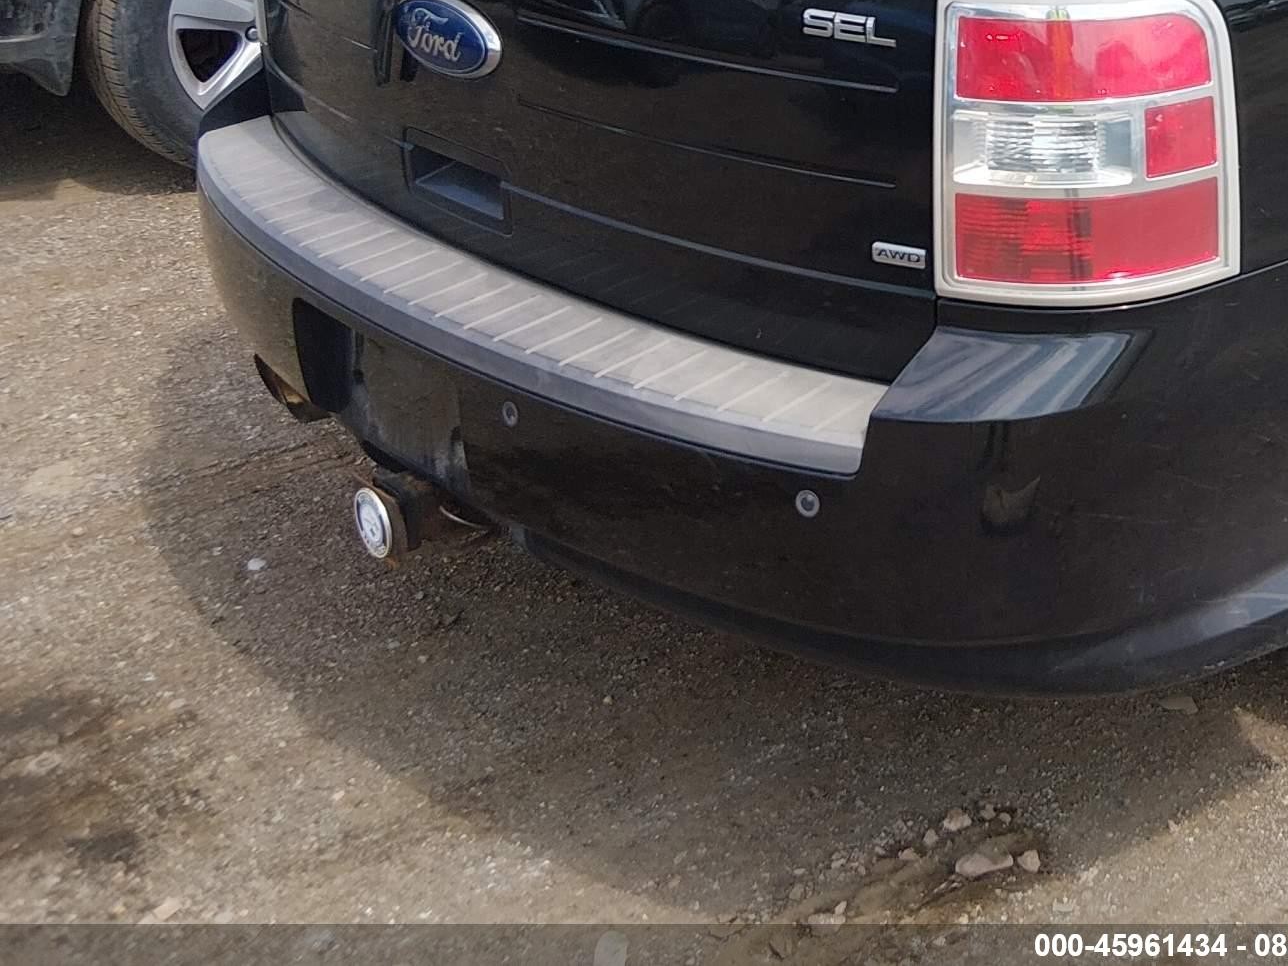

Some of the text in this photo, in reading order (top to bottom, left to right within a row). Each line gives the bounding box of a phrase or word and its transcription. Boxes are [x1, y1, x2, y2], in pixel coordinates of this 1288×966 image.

[404, 7, 465, 63] Ford
[802, 8, 897, 48] SEL
[877, 248, 922, 264] AWD
